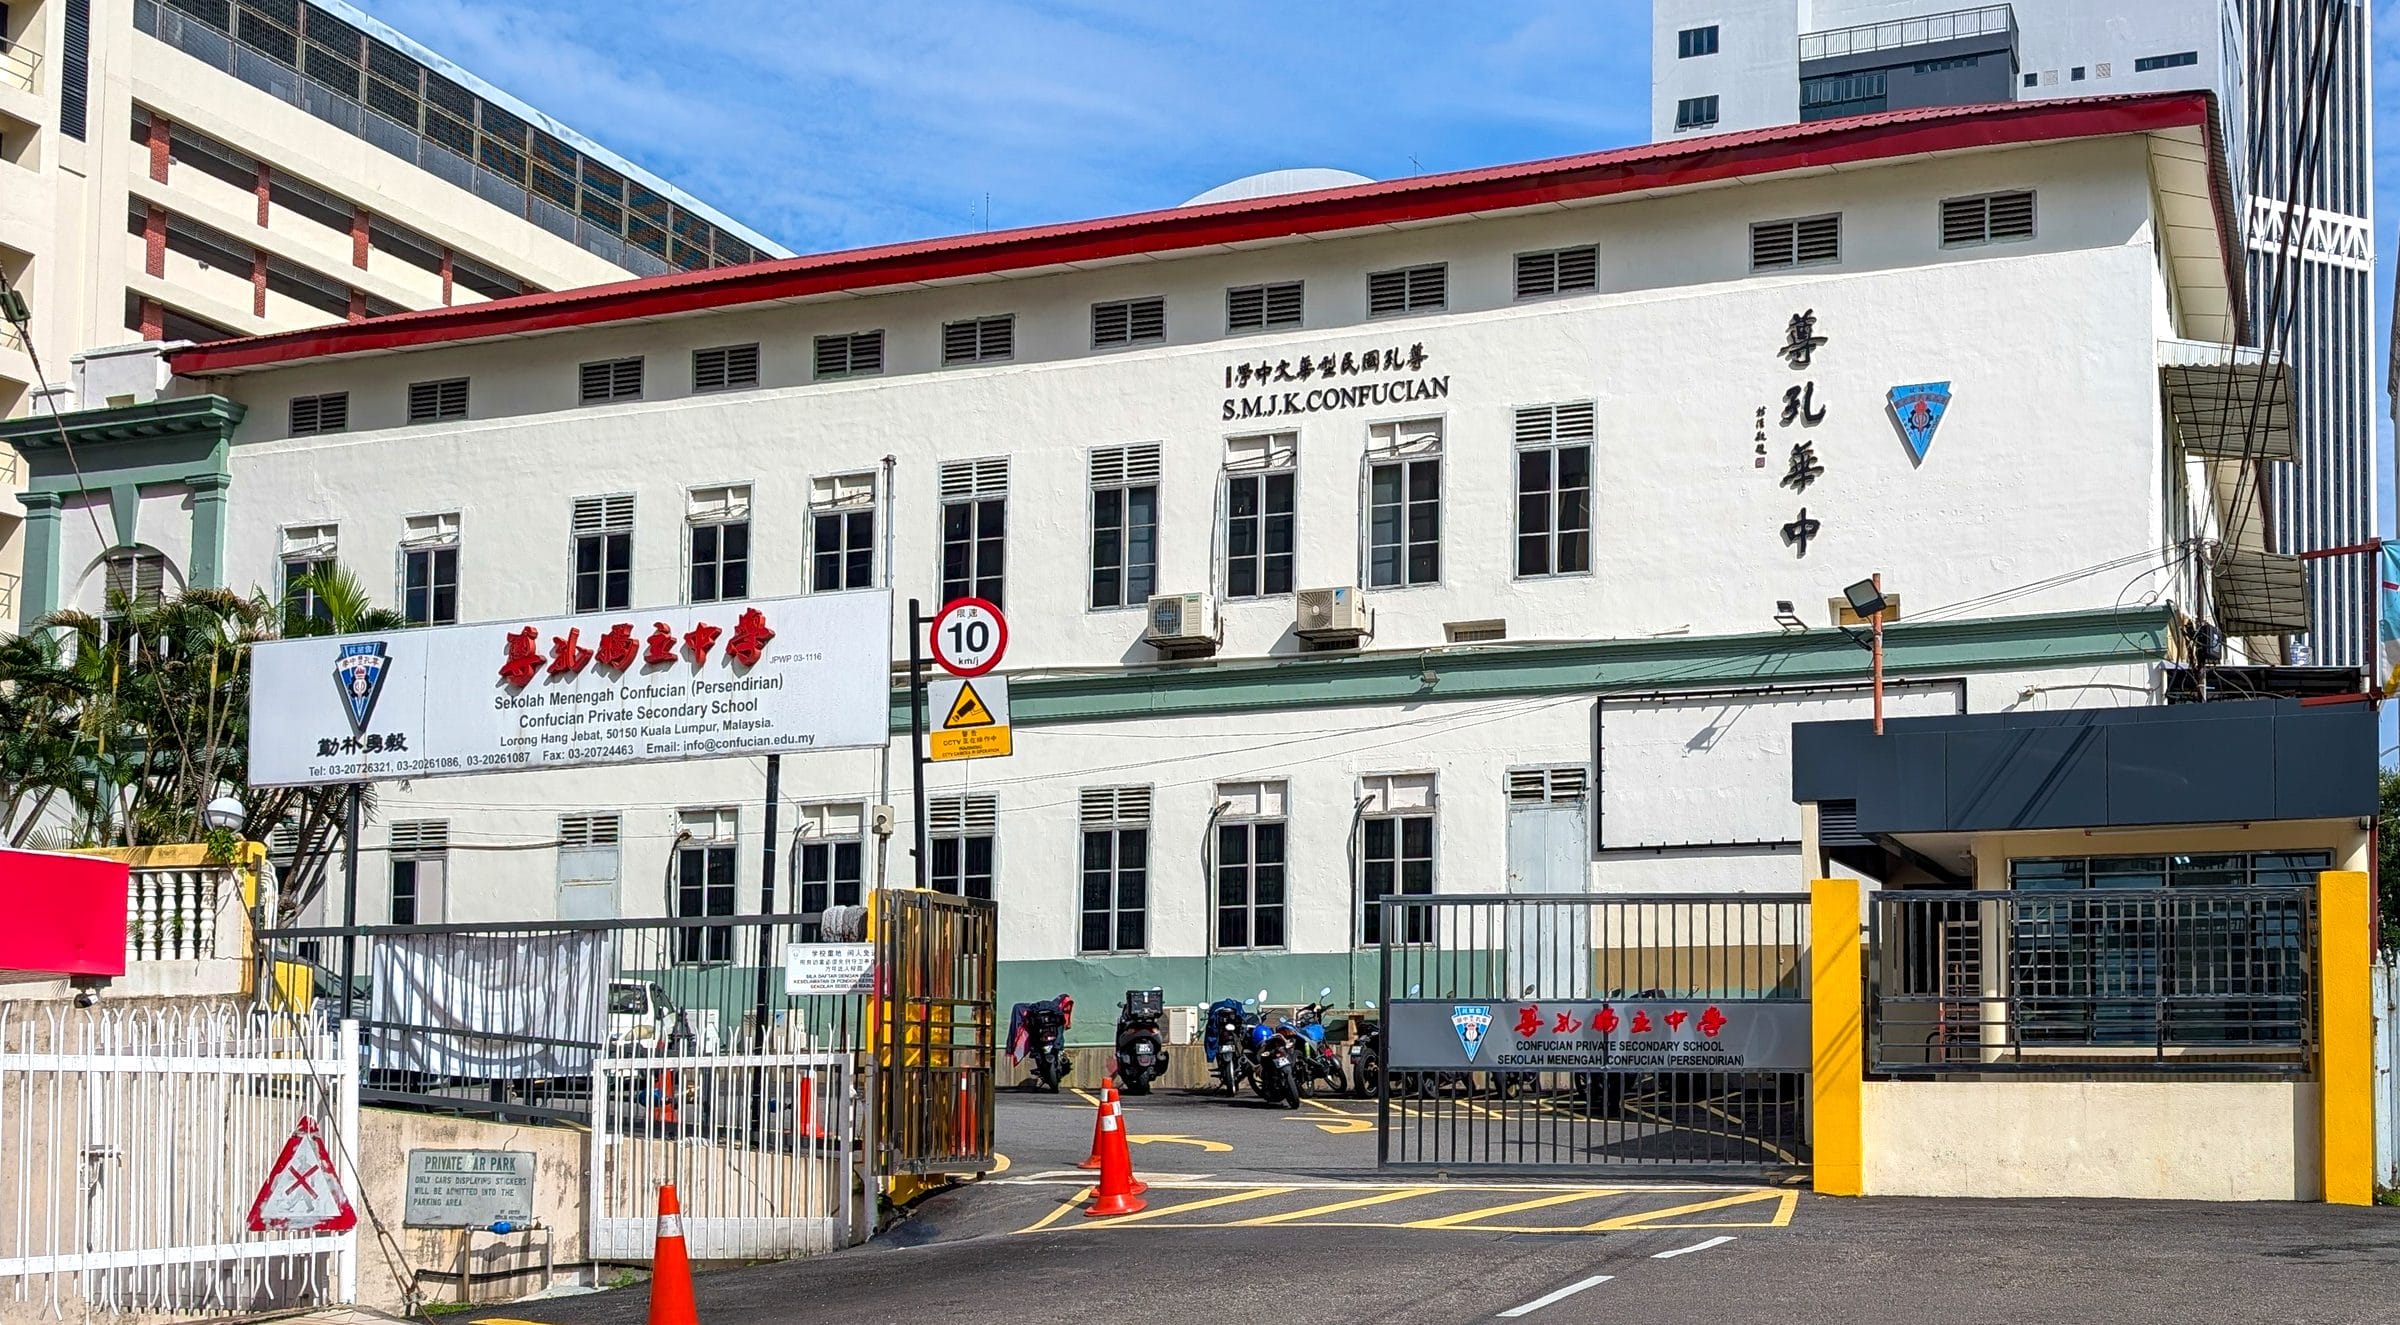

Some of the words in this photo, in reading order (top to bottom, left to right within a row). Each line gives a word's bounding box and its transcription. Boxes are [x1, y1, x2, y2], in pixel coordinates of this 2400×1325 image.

[947, 621, 989, 653] 10
[769, 655, 792, 664] JPWP
[793, 653, 822, 662] 03-1116
[958, 656, 979, 666] km/j
[494, 695, 545, 710] Sekolah
[549, 688, 614, 706] Menengah
[620, 684, 686, 700] Confucian
[691, 673, 784, 697] (Persendirian)
[519, 711, 585, 729] Confucian
[588, 709, 634, 724] Private
[636, 703, 709, 720] Secondary
[711, 697, 759, 714] School
[500, 735, 538, 747] Lorong
[540, 733, 568, 746] Hang
[571, 730, 603, 742] Jebat,
[606, 727, 638, 740] 50150
[640, 724, 672, 737] Kuala
[674, 722, 720, 736] Lumpur,
[722, 717, 775, 732] Malaysia.
[308, 766, 326, 777] Tel:
[328, 761, 394, 775] 03-20726321,
[396, 756, 462, 771] 03-20261086,
[466, 751, 531, 767] 03-20261087
[542, 750, 565, 762] Fax:
[568, 744, 634, 759] 03-20724463
[646, 741, 681, 754] Email:
[683, 733, 816, 752] info@confucian.edu.my
[1516, 1040, 1573, 1051] CONFUCIAN
[1576, 1040, 1617, 1051] PRIVATE
[1619, 1041, 1680, 1052] SECONDARY
[1682, 1041, 1725, 1052] SCHOOL
[1497, 1054, 1544, 1065] SEKOLAH
[1547, 1054, 1601, 1065] MENENGAH
[1606, 1055, 1665, 1066] CONFUCIAN
[1667, 1054, 1745, 1067] (PERSENDIRIAN)
[424, 1156, 463, 1171] PRIVATE
[490, 1157, 516, 1171] PARK
[414, 1176, 431, 1184] ONLY
[435, 1176, 452, 1185] CARS
[433, 1187, 443, 1195] BE
[501, 1188, 515, 1197] THE
[413, 1198, 442, 1206] PARKING
[446, 1199, 462, 1207] AREA
